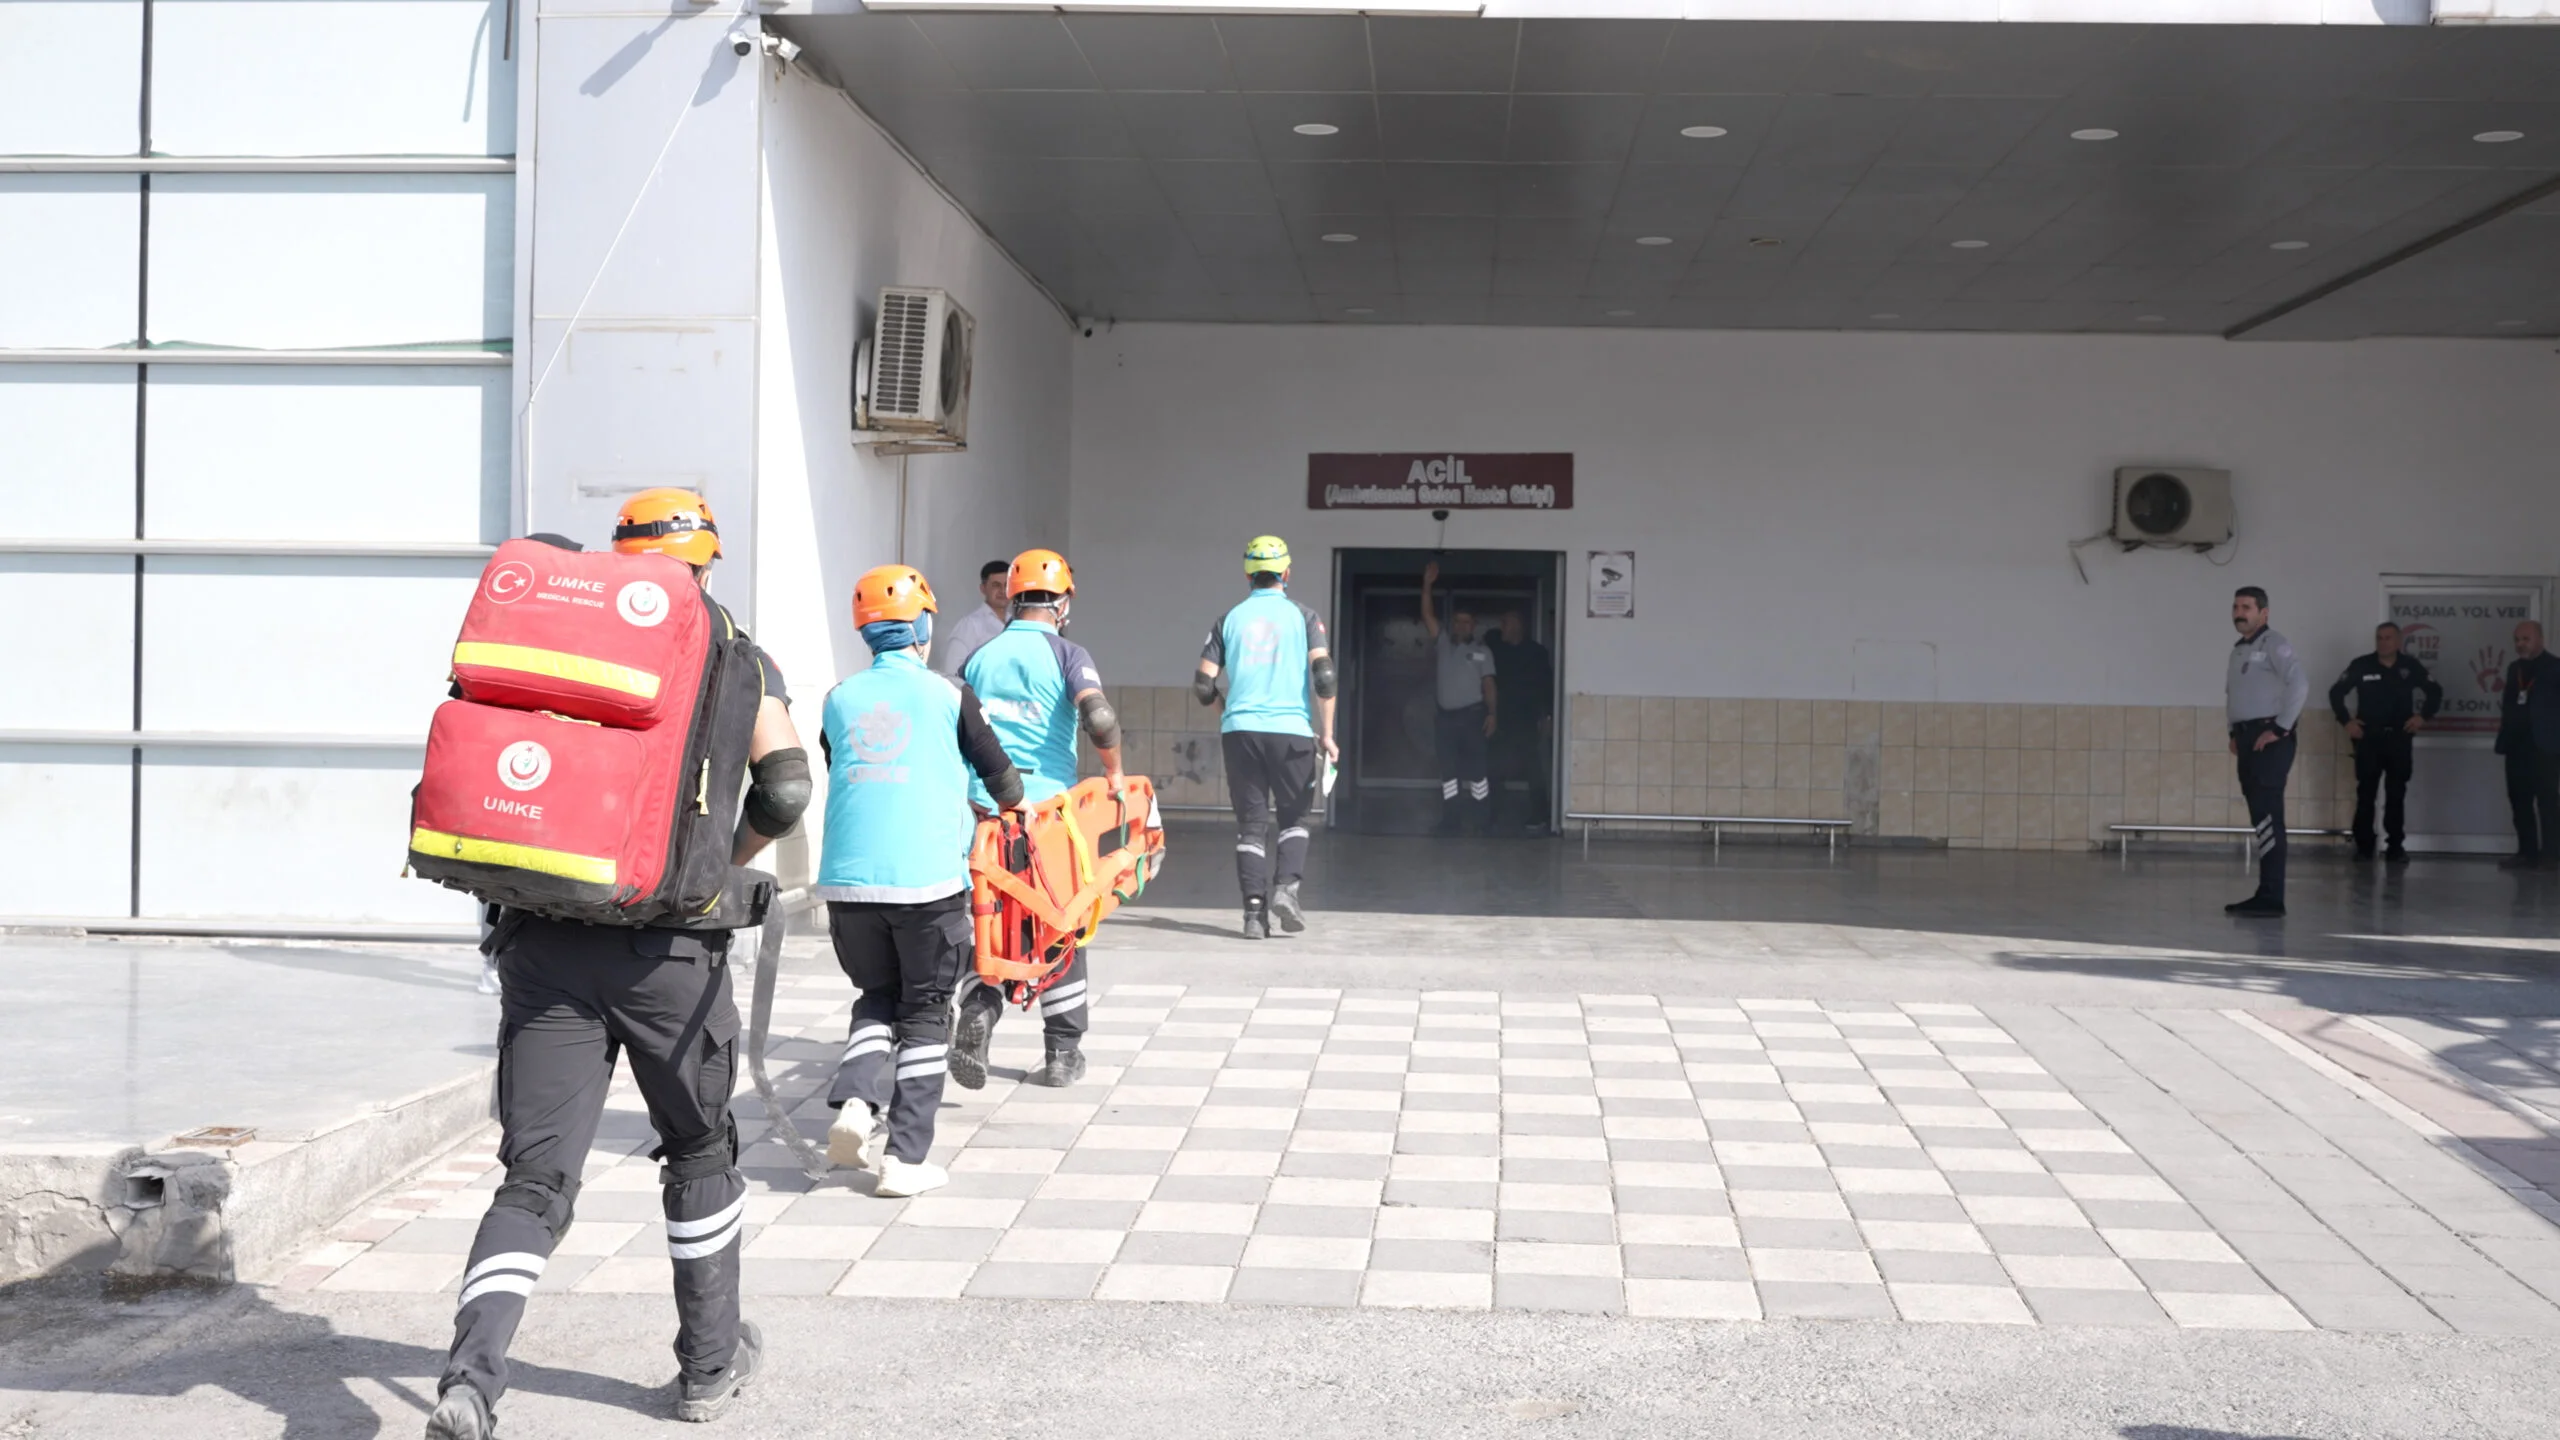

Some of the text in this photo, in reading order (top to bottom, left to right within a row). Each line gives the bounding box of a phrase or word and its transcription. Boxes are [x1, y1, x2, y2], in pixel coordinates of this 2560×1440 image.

[1406, 454, 1472, 483] ACİL
[548, 575, 606, 593] UMKE
[2393, 606, 2527, 619] YAŞAMA YOL VER
[2418, 636, 2440, 649] 112
[2456, 700, 2490, 712] SON
[847, 766, 909, 784] UMKE
[483, 796, 544, 820] UMKE
